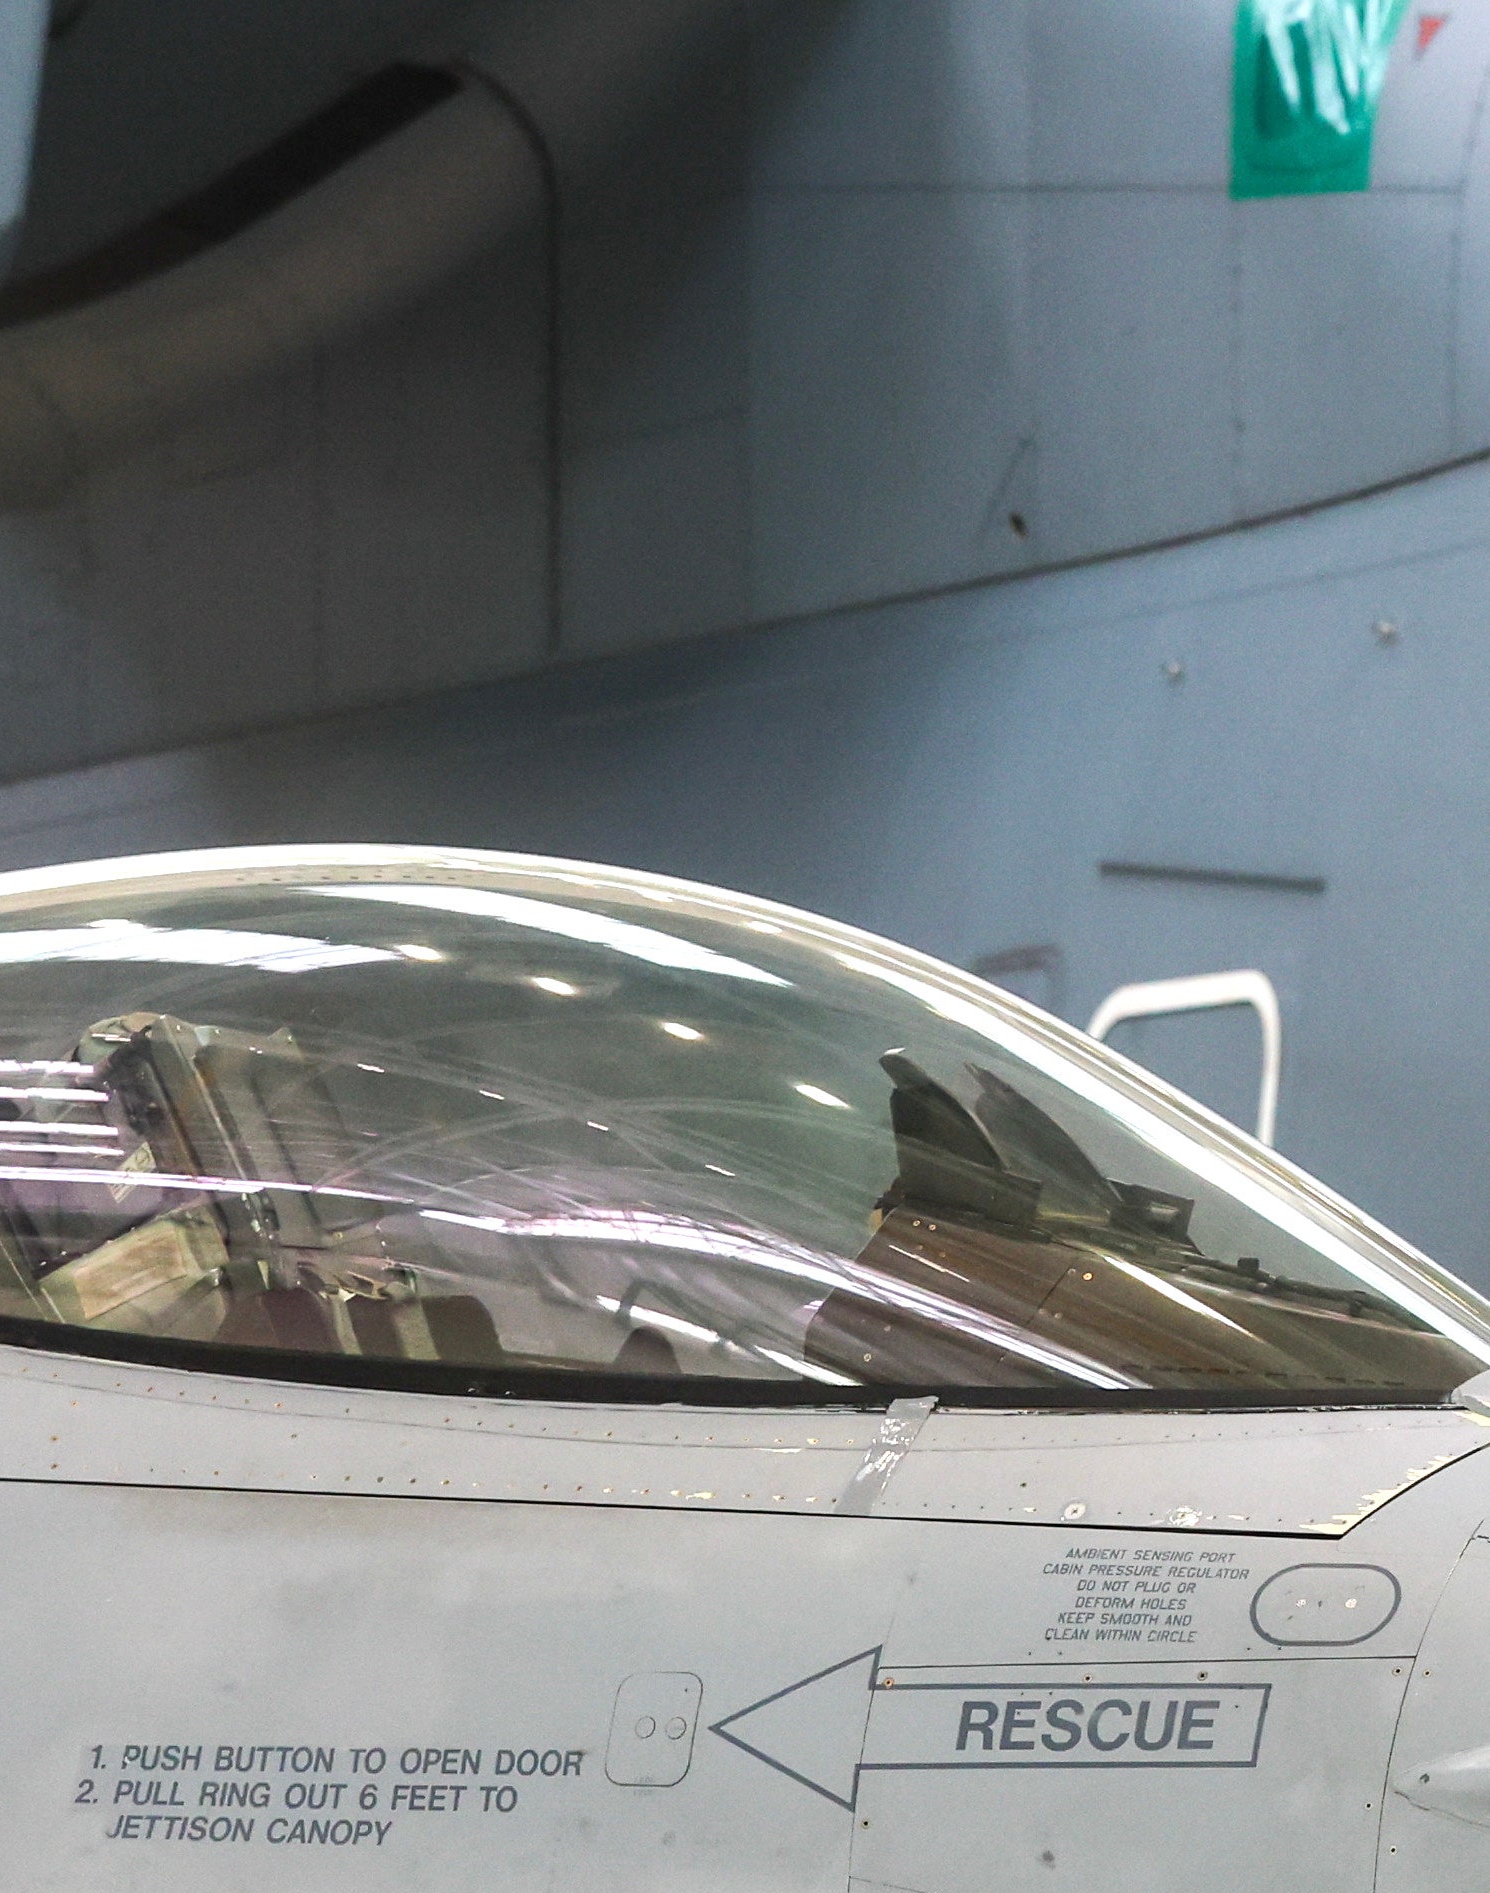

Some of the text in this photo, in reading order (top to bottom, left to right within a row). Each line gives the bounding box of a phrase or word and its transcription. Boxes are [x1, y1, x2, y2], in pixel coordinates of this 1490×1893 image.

[1066, 1548, 1236, 1563] AMBIENT SENSING PORT
[1043, 1564, 1249, 1580] CABIN PRESSURE REGULATOR
[1077, 1580, 1196, 1593] DO NOT PLUG OR
[1075, 1597, 1187, 1610] DEFORM HOLES
[1058, 1612, 1192, 1626] KEEP SMOOTH AND
[1045, 1628, 1197, 1643] CLEAN WITHIN CIRCLE
[955, 1701, 1220, 1750] RESCUE
[91, 1746, 584, 1776] 1. PUSH BUTTON TO OPEN DOOR
[76, 1780, 517, 1812] 2. PULL RING OUT 6 FEET TO
[106, 1815, 391, 1846] JETTISON CANOPY
